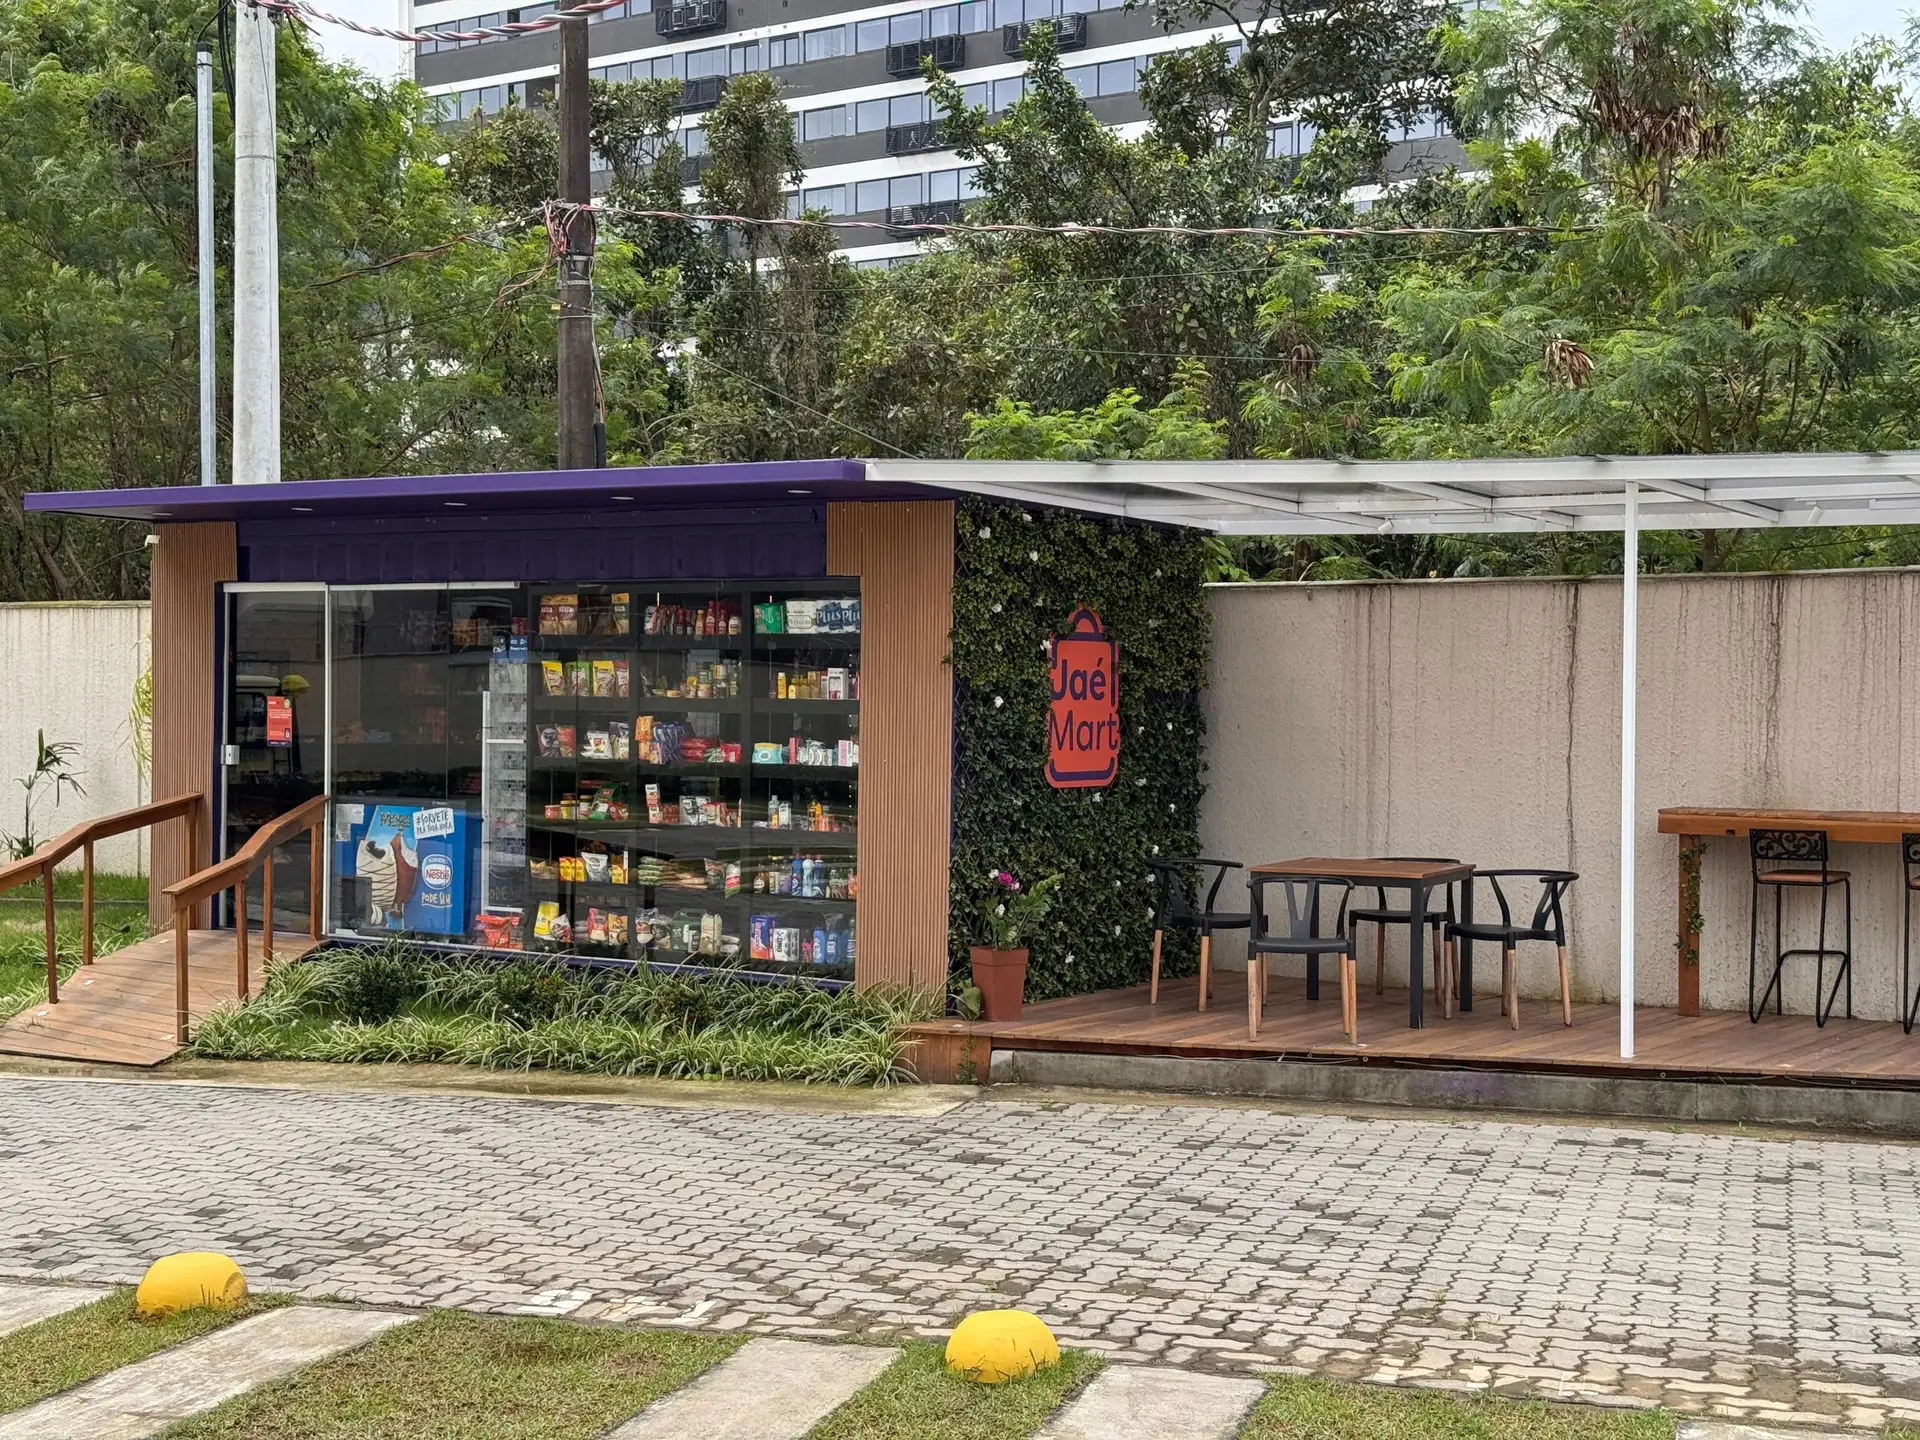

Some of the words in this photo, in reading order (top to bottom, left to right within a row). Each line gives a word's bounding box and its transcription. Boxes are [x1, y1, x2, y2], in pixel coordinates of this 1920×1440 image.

[816, 609, 841, 623] Plus
[842, 609, 860, 623] Plu
[1051, 657, 1106, 700] Jaé
[1048, 709, 1118, 751] Mart
[416, 810, 449, 825] #SORVETE
[427, 823, 439, 833] TODA
[421, 891, 438, 904] PODE
